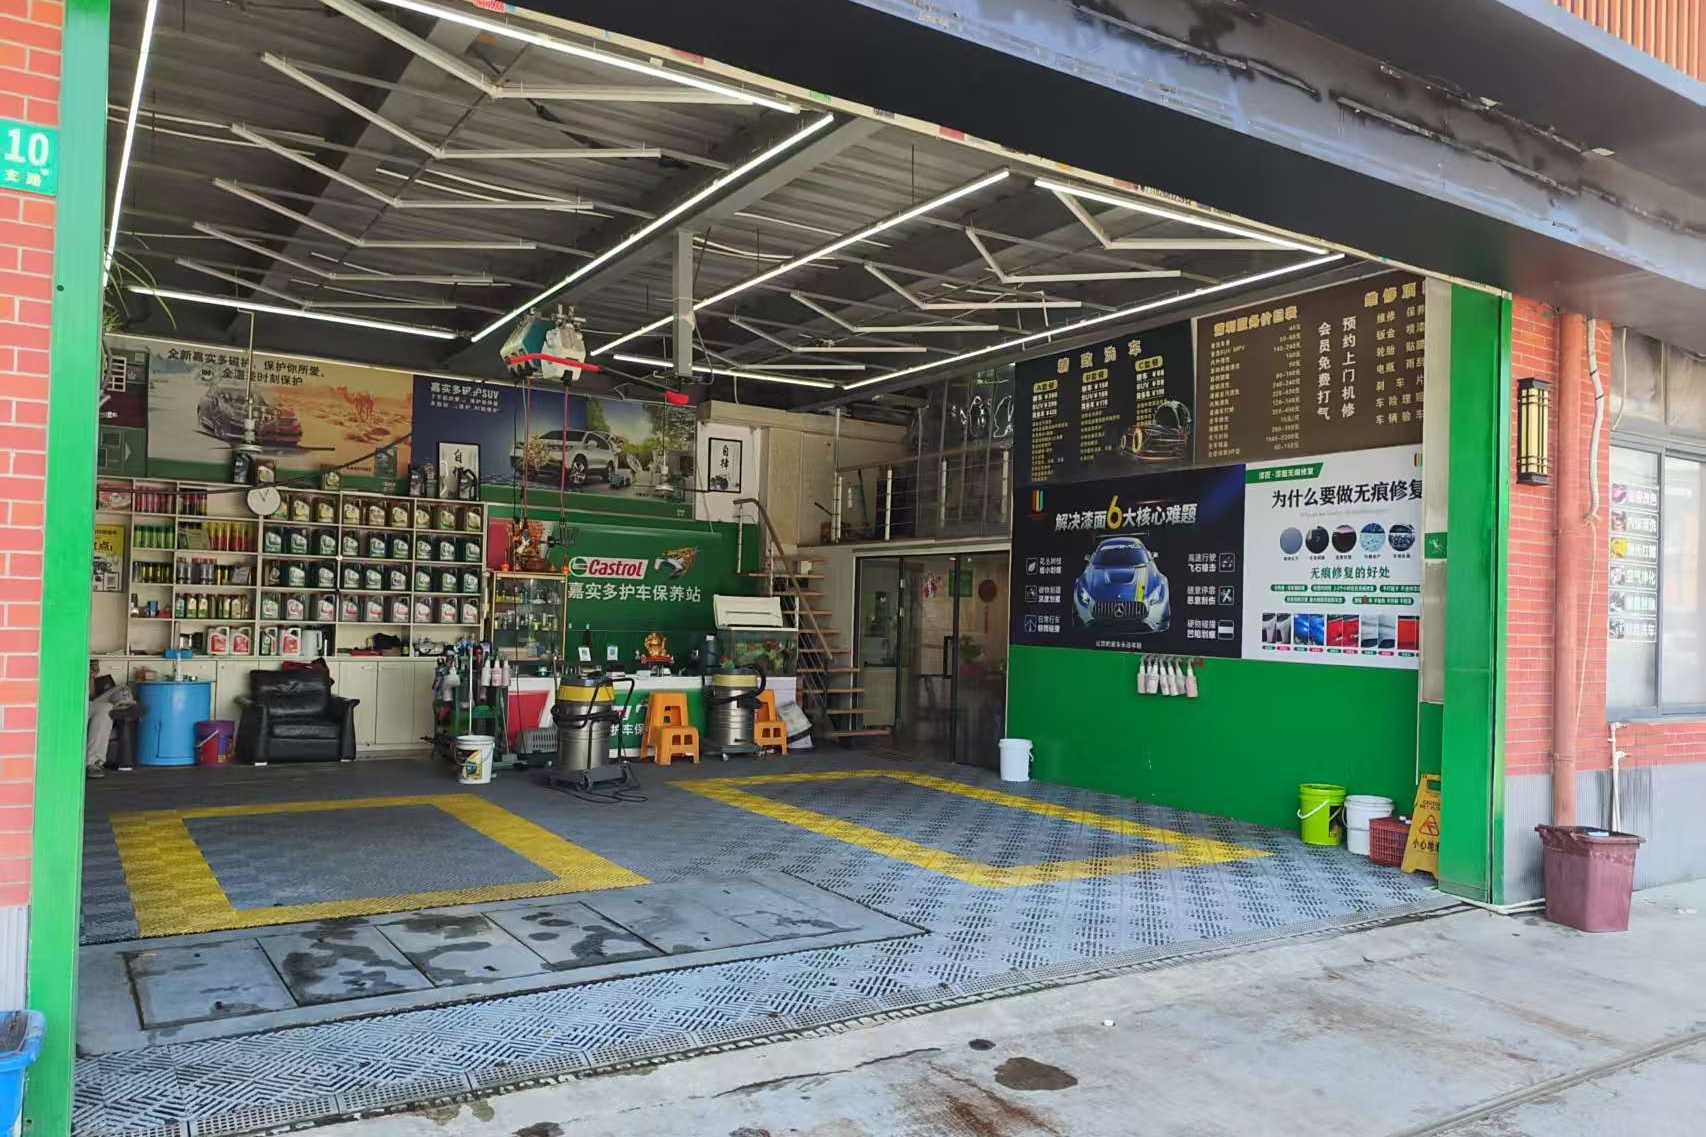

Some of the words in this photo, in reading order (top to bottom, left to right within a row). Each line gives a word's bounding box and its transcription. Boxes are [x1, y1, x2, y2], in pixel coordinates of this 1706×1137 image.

[4, 128, 49, 167] 10
[1317, 321, 1332, 421] 会员免费打气
[1341, 315, 1357, 418] 预约上门机修
[1271, 479, 1423, 509] 为什么要做无痕修复
[1055, 495, 1198, 532] 解决漆面6大核心难题
[588, 556, 643, 577] Castrol
[1310, 566, 1391, 580] 无痕修复的好处
[567, 582, 701, 603] 嘉实多护车保养站
